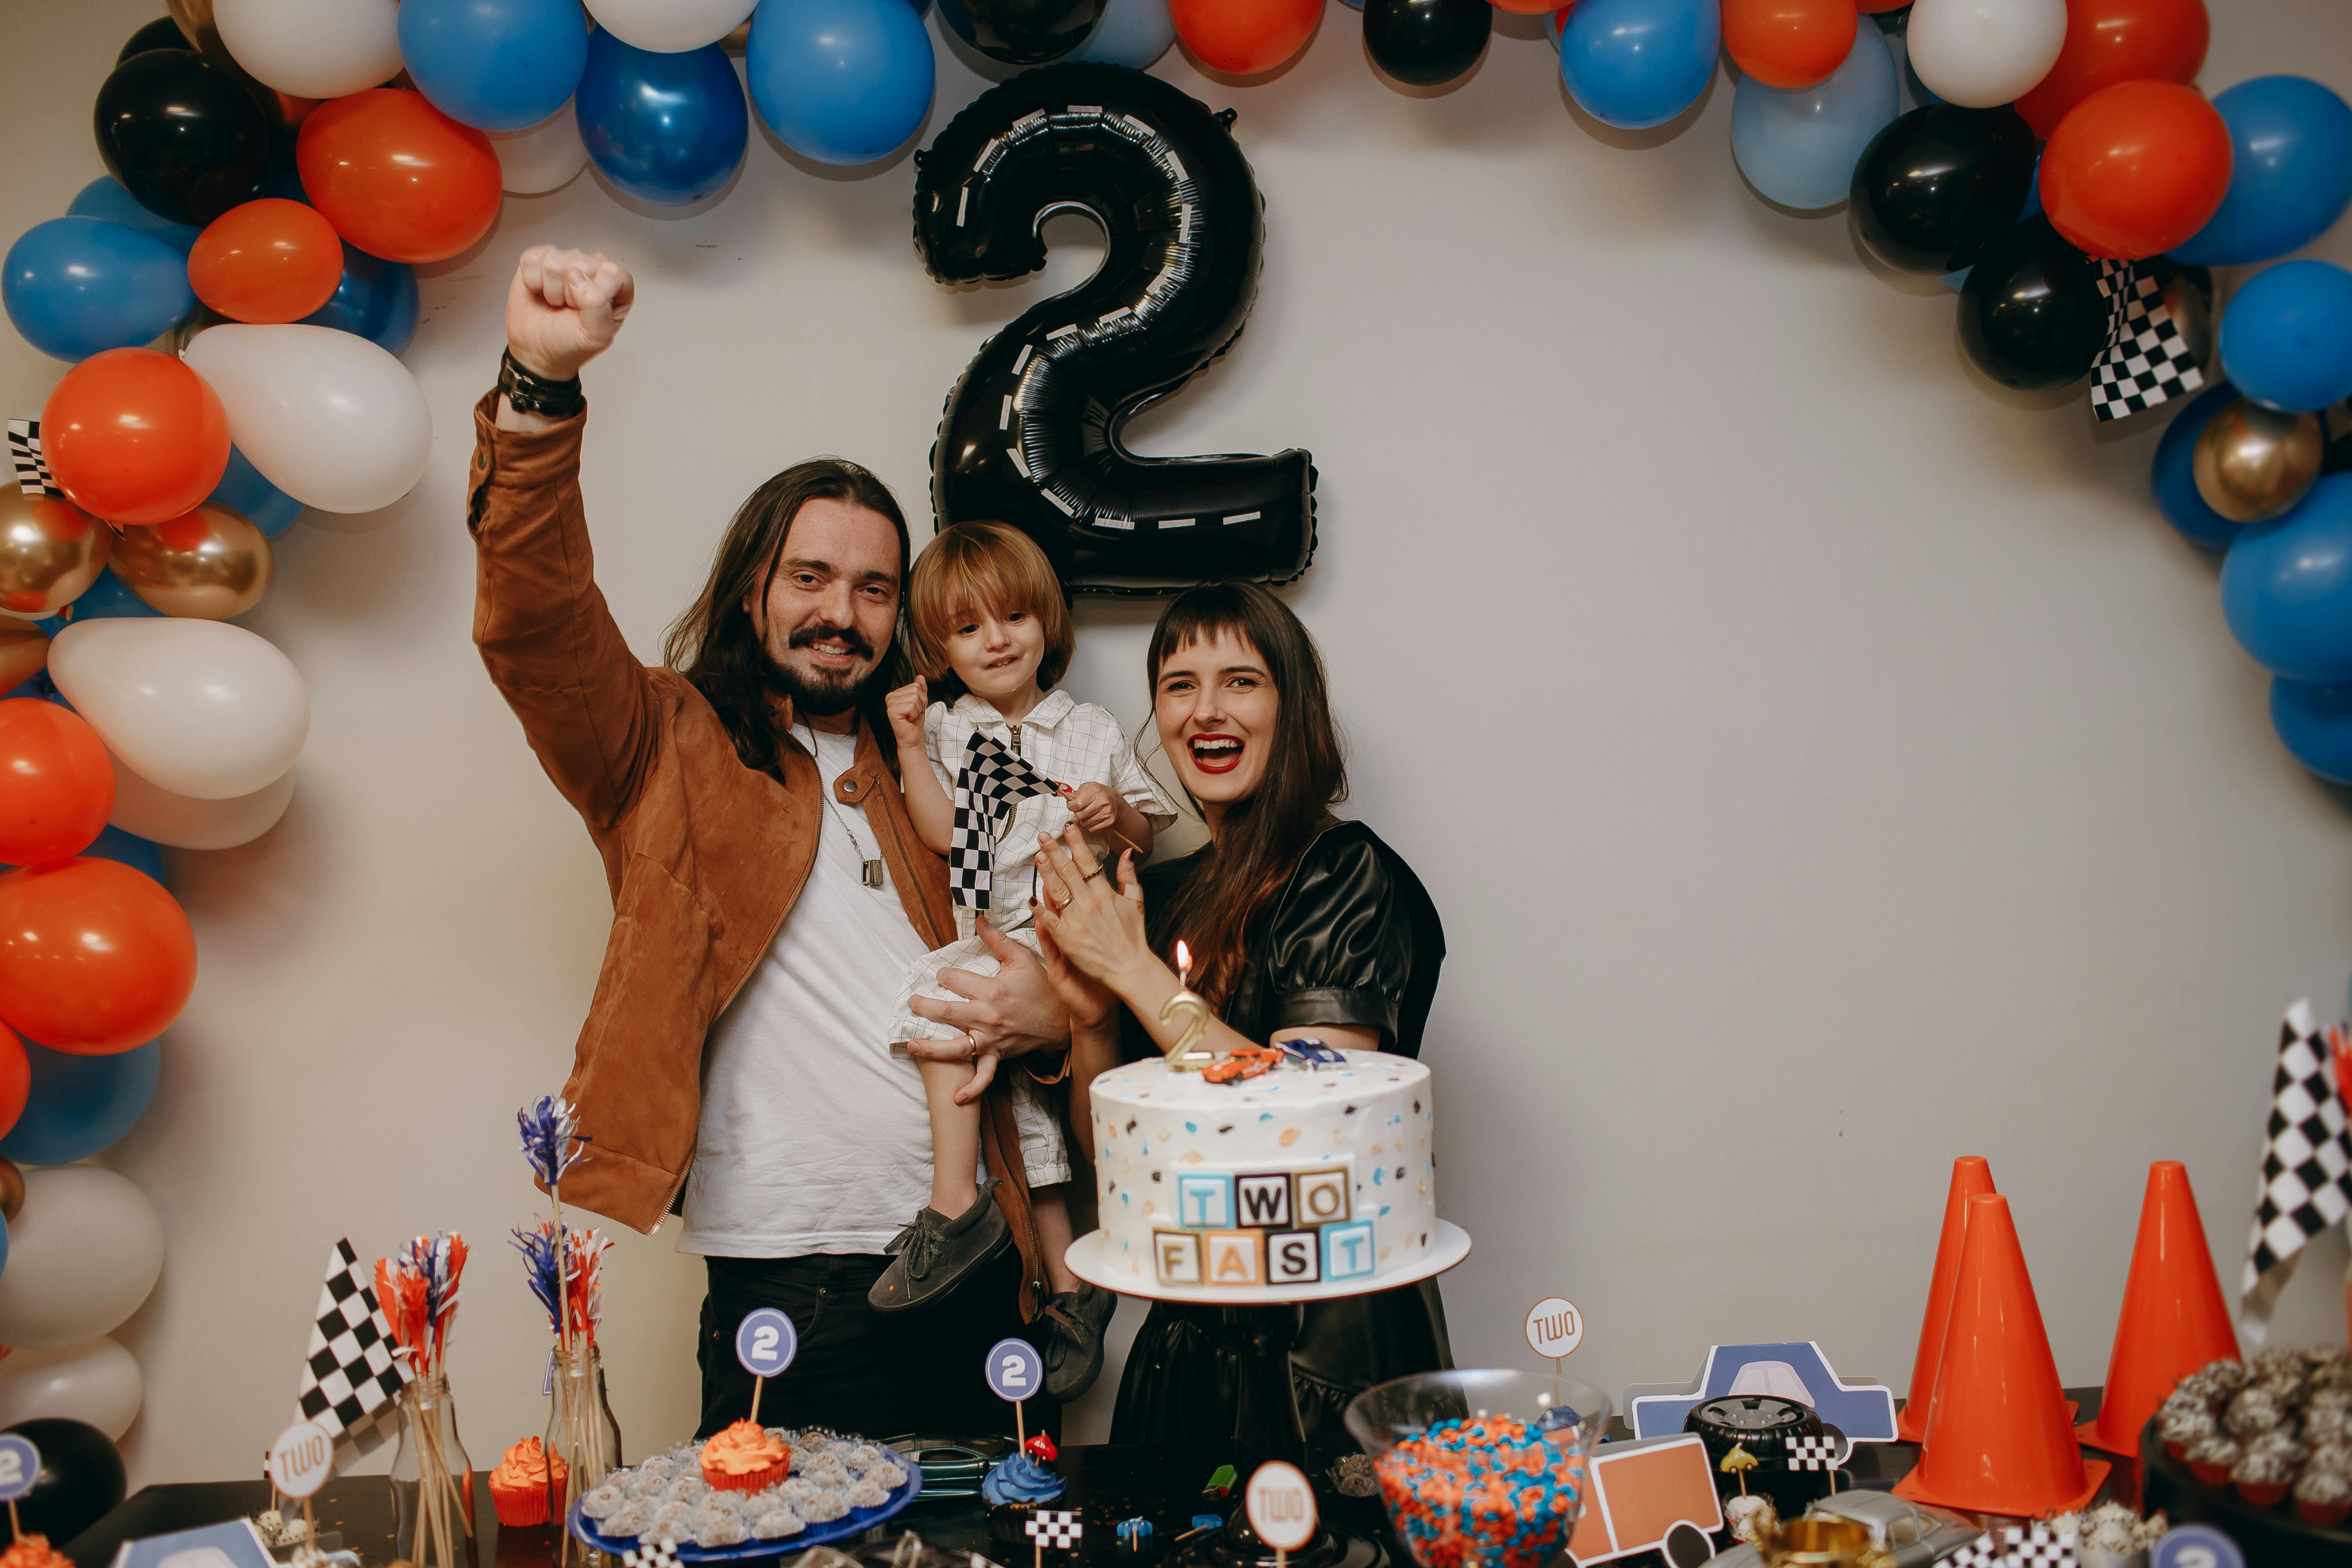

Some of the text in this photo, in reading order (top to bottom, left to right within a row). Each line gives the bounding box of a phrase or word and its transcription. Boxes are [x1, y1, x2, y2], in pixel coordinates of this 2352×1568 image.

[913, 61, 1319, 597] 2
[1159, 991, 1215, 1072] 2
[1189, 1183, 1340, 1222] TWO
[1164, 1234, 1365, 1277] FAST
[752, 1325, 779, 1361] 2
[1533, 1311, 1575, 1344] TWO
[1002, 1355, 1026, 1387] 2
[279, 1435, 324, 1482] TWO
[1257, 1487, 1304, 1522] TWO
